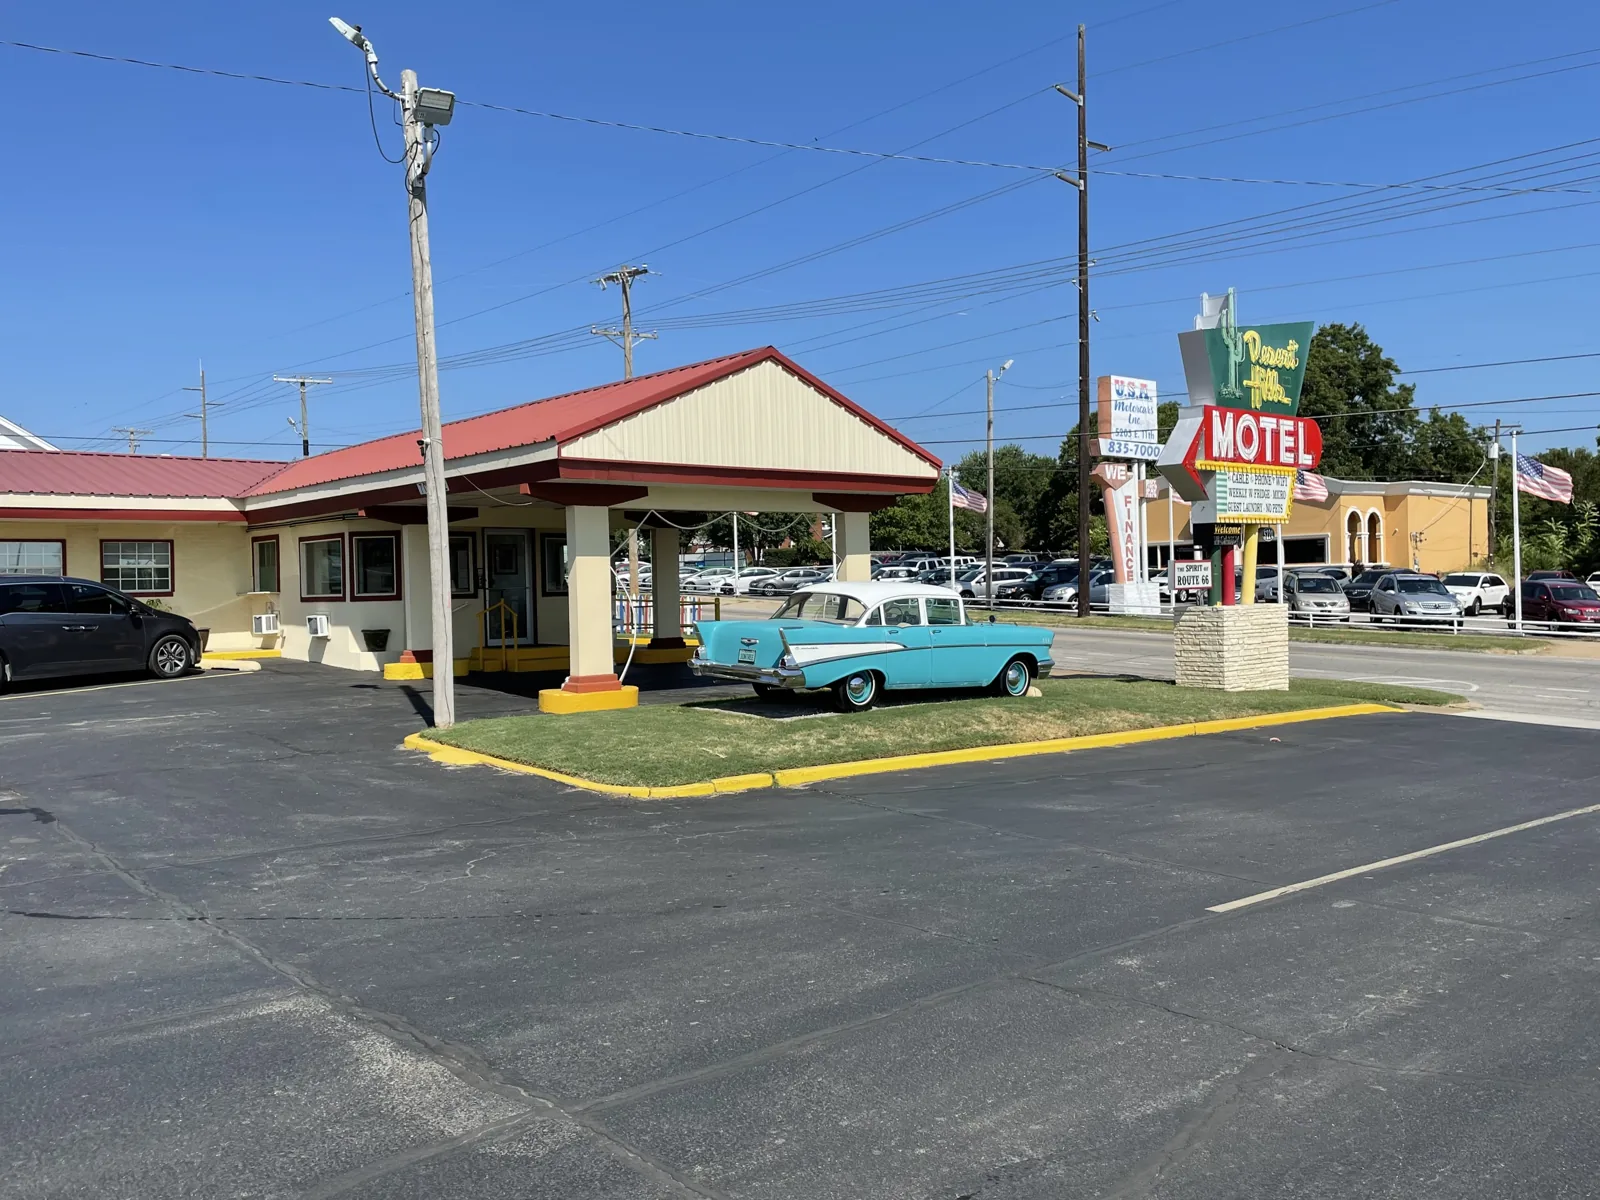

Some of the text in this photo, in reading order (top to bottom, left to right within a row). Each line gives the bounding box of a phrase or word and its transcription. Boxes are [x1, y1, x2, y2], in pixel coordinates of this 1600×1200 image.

[1114, 400, 1154, 415] Motorcars
[1212, 409, 1313, 465] MOTEL
[1108, 441, 1161, 458] 835-7000
[1105, 464, 1126, 480] WE
[1232, 473, 1288, 487] CABLE PHONE WIFI
[1228, 487, 1247, 498] WEEKLY
[1253, 488, 1270, 499] FRIDGE
[1272, 489, 1286, 500] MICRO
[1228, 501, 1284, 514] GUEST LAUNDRY NO PETS
[1214, 524, 1241, 535] Welcome
[1124, 495, 1134, 582] FINANCE
[1185, 564, 1203, 573] SPIRIT
[1177, 574, 1210, 586] ROUTE 66
